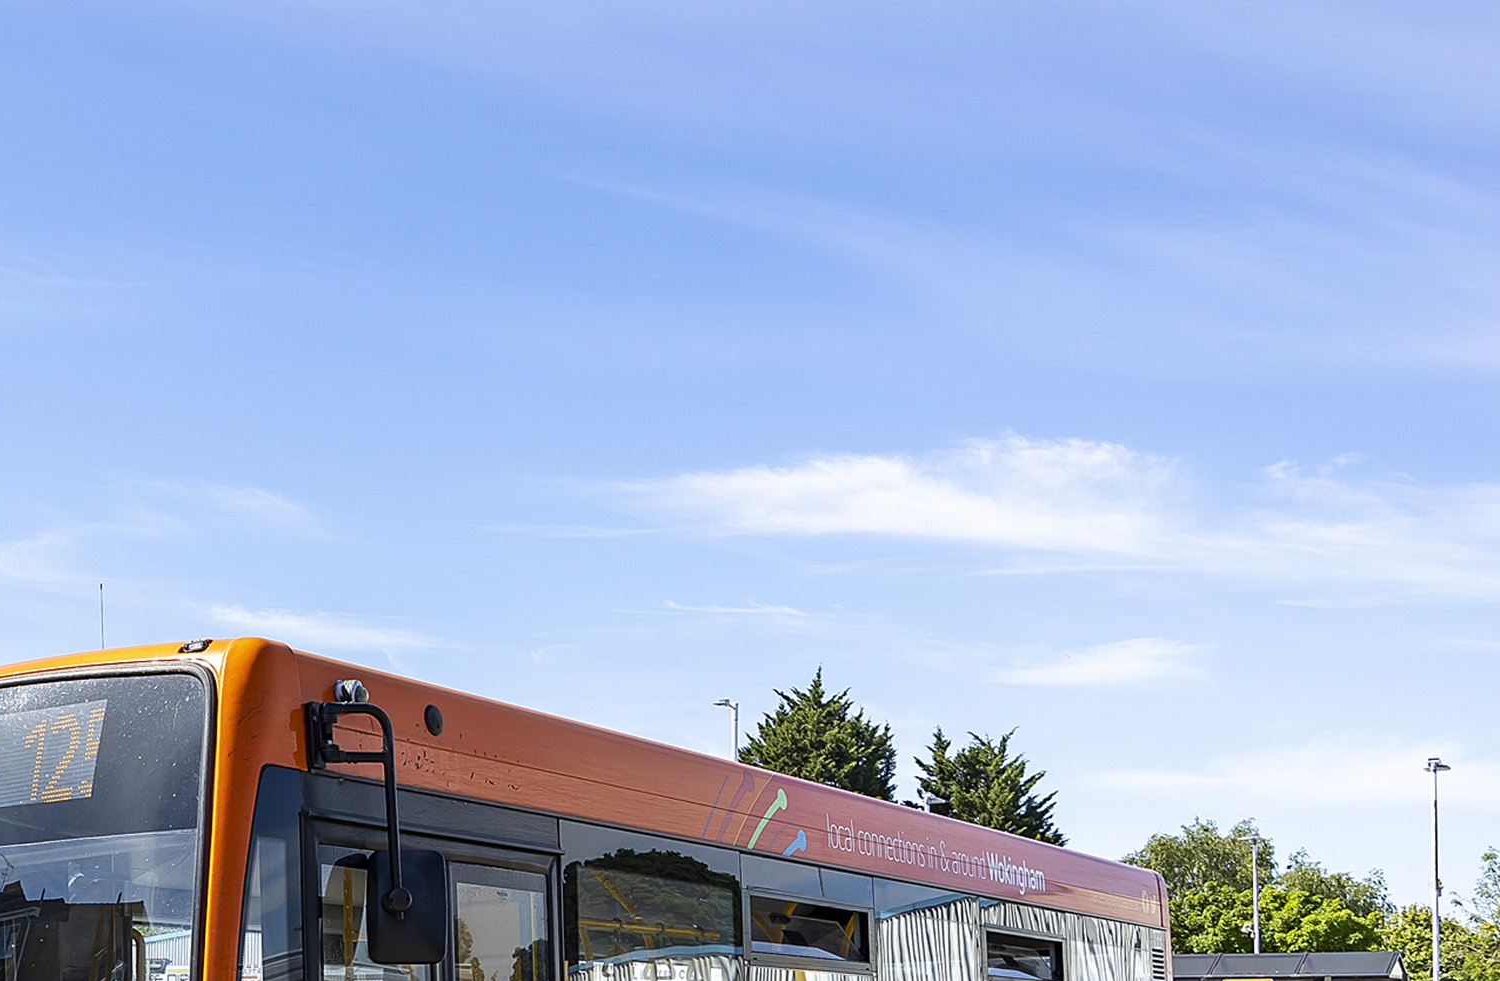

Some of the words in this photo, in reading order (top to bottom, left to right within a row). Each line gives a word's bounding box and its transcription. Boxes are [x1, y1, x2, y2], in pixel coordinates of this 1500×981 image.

[825, 813, 856, 853] local
[857, 830, 926, 868] connections
[926, 837, 939, 870] in
[939, 840, 951, 873] &
[951, 850, 987, 880] around
[986, 851, 1046, 896] Wokingham
